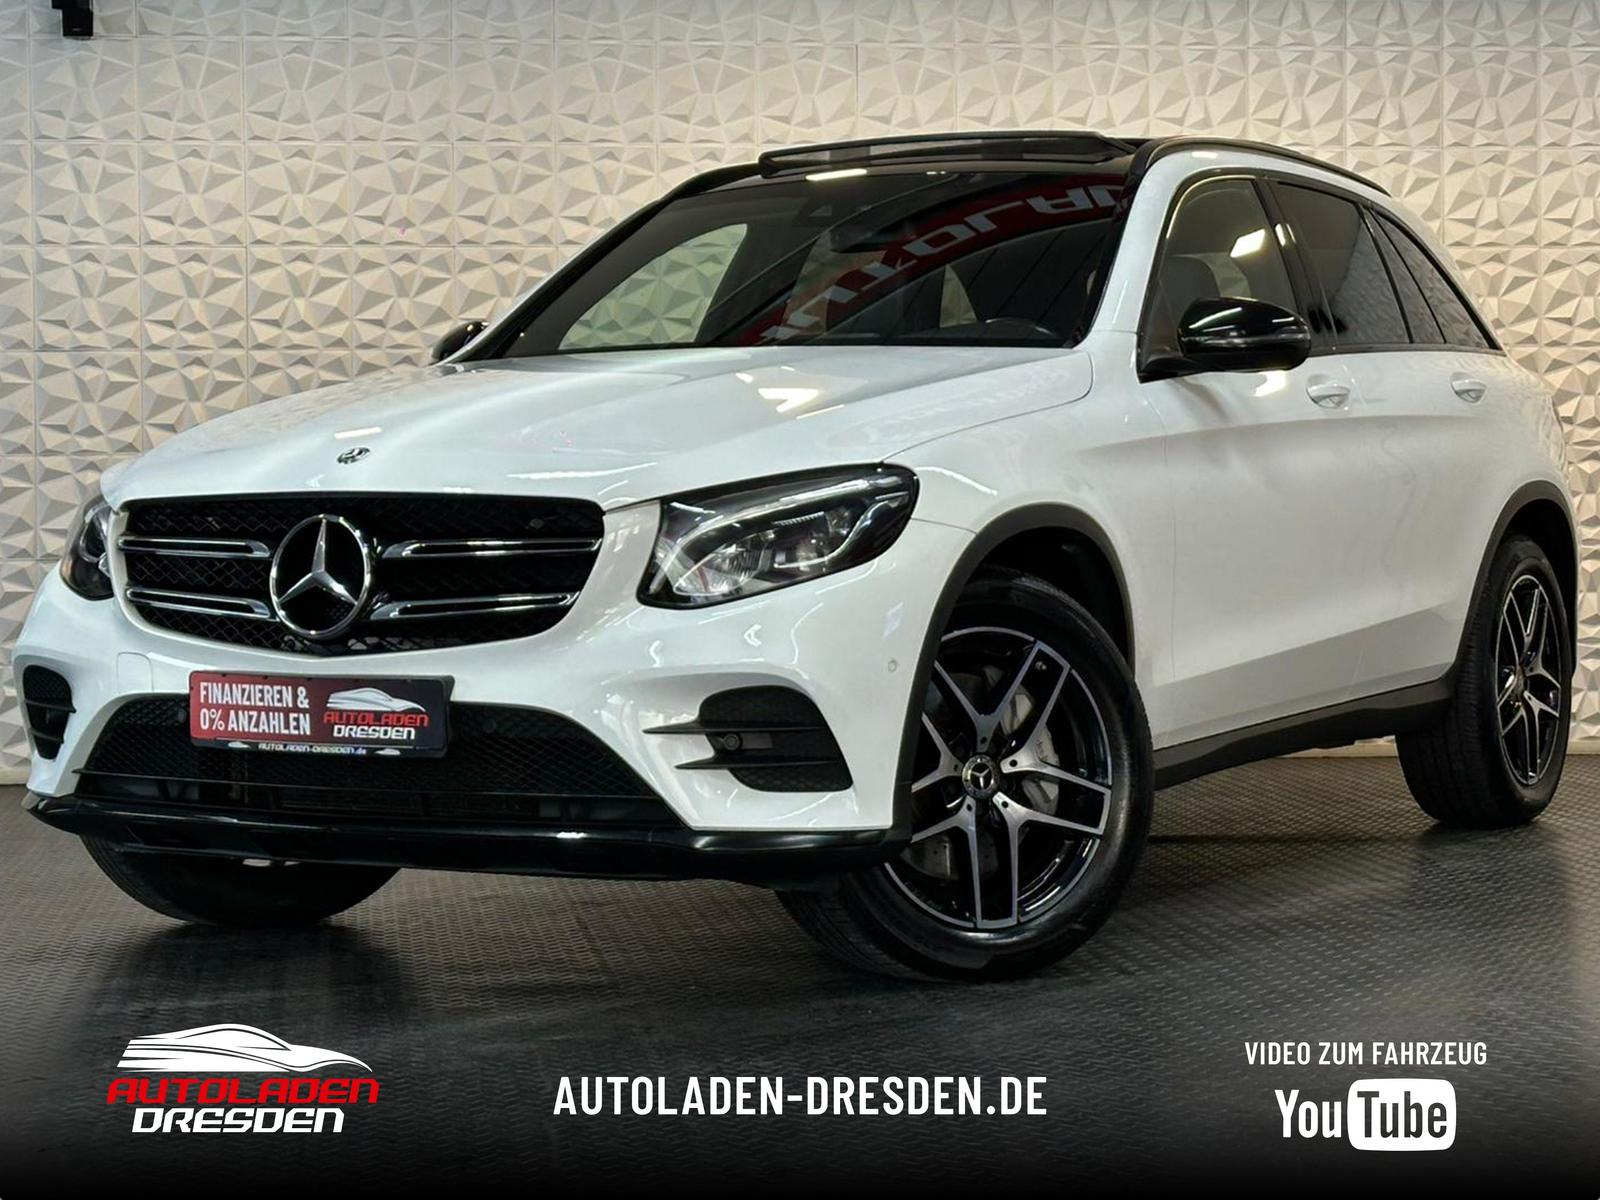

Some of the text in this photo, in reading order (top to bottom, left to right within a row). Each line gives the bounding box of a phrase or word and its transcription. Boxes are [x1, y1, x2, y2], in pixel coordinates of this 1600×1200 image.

[200, 682, 310, 709] FINANZIEREN &
[200, 708, 311, 735] 0% ANZAHLEN
[323, 711, 429, 726] AUTOLADEN
[333, 725, 415, 740] DRESDEN
